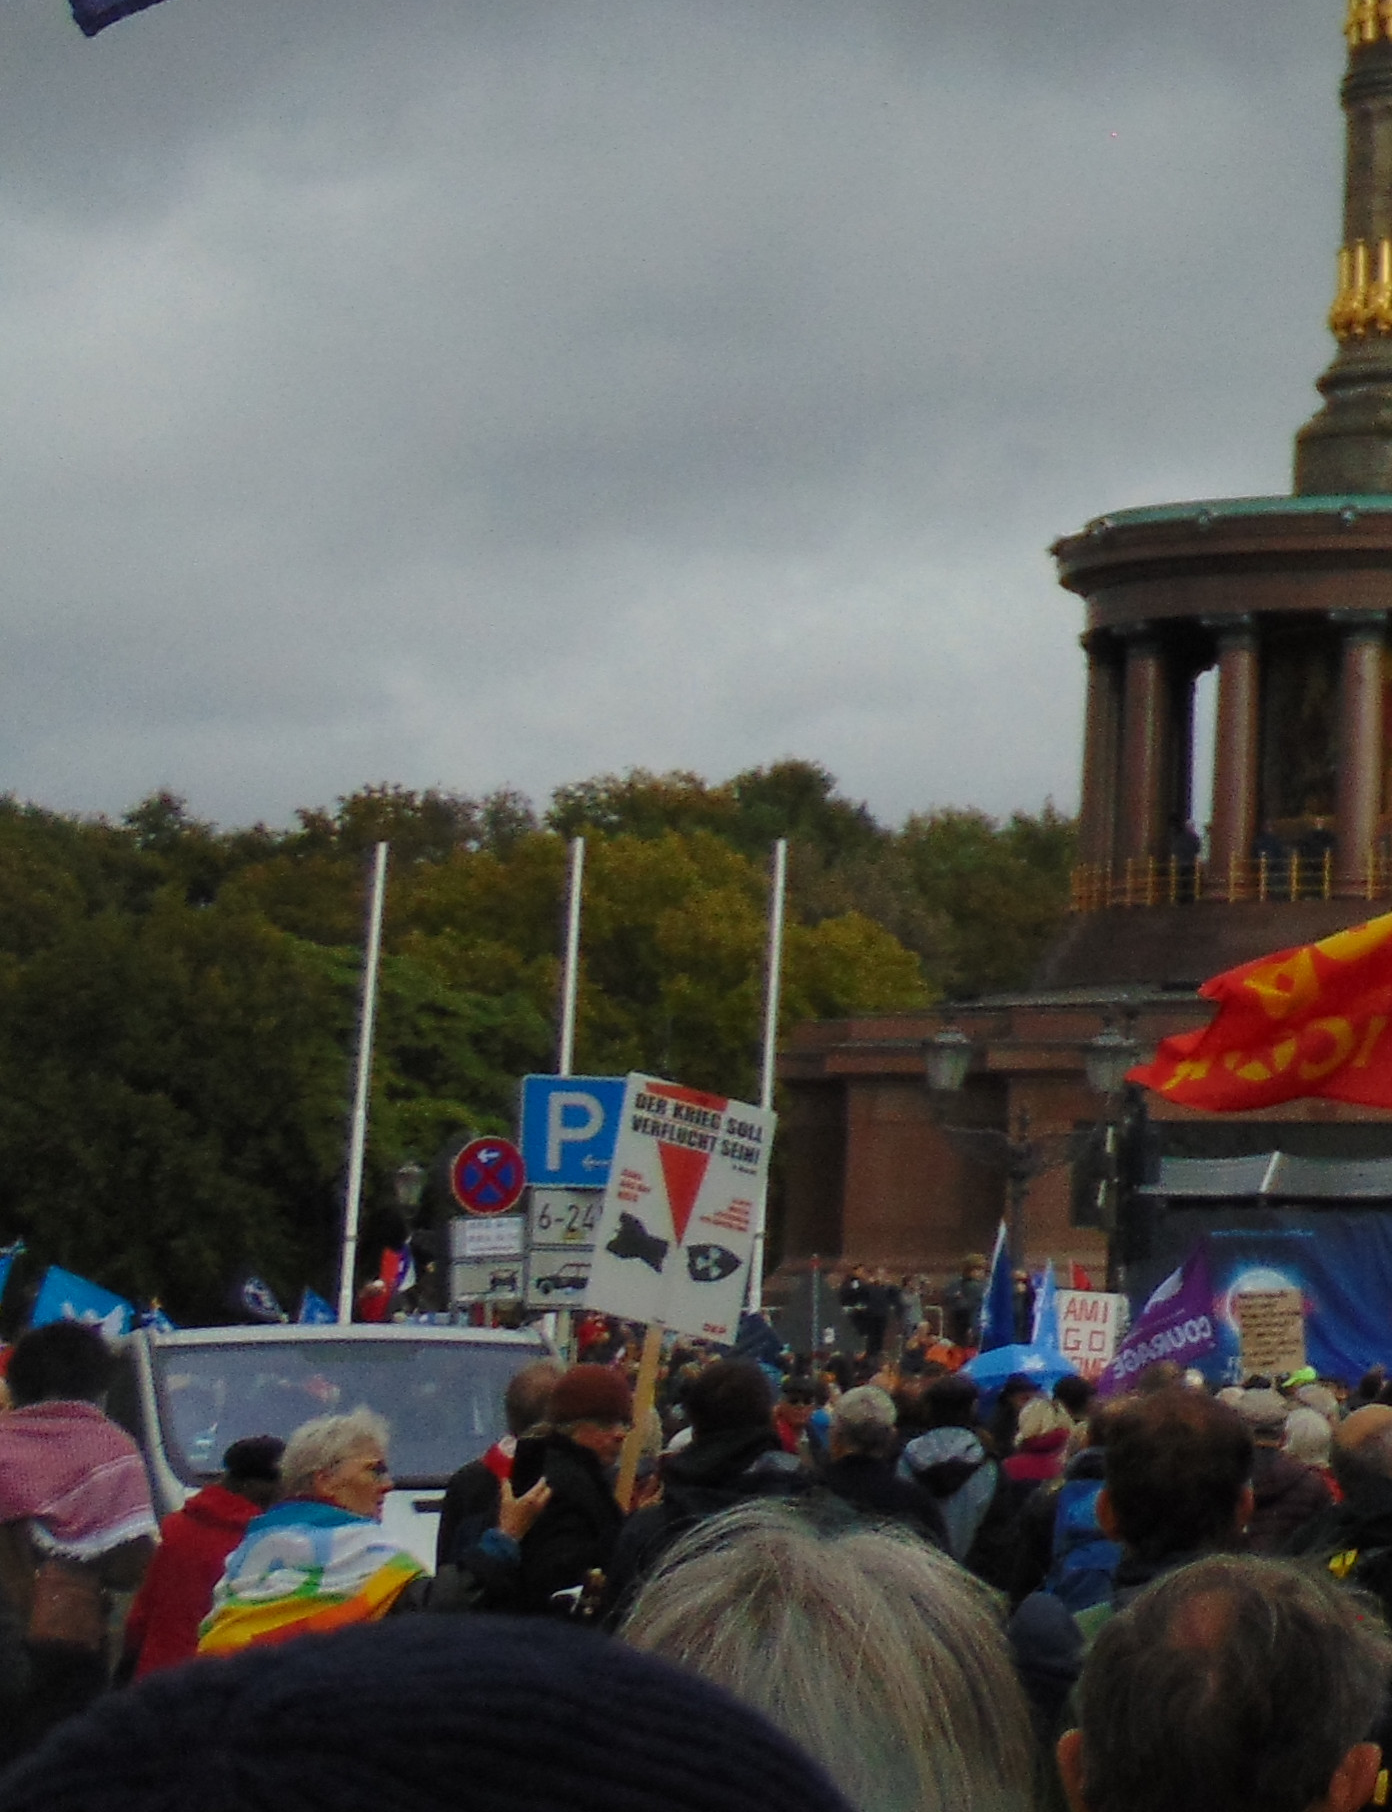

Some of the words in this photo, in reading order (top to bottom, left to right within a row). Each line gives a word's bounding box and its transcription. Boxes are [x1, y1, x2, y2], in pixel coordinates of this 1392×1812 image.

[546, 1091, 605, 1172] P
[631, 1114, 717, 1153] VERFLUCHT
[634, 1092, 668, 1117] DER
[672, 1101, 722, 1131] KRIEG
[726, 1117, 763, 1144] SOLL
[538, 1203, 604, 1233] 6-24
[1063, 1296, 1109, 1324] AMI
